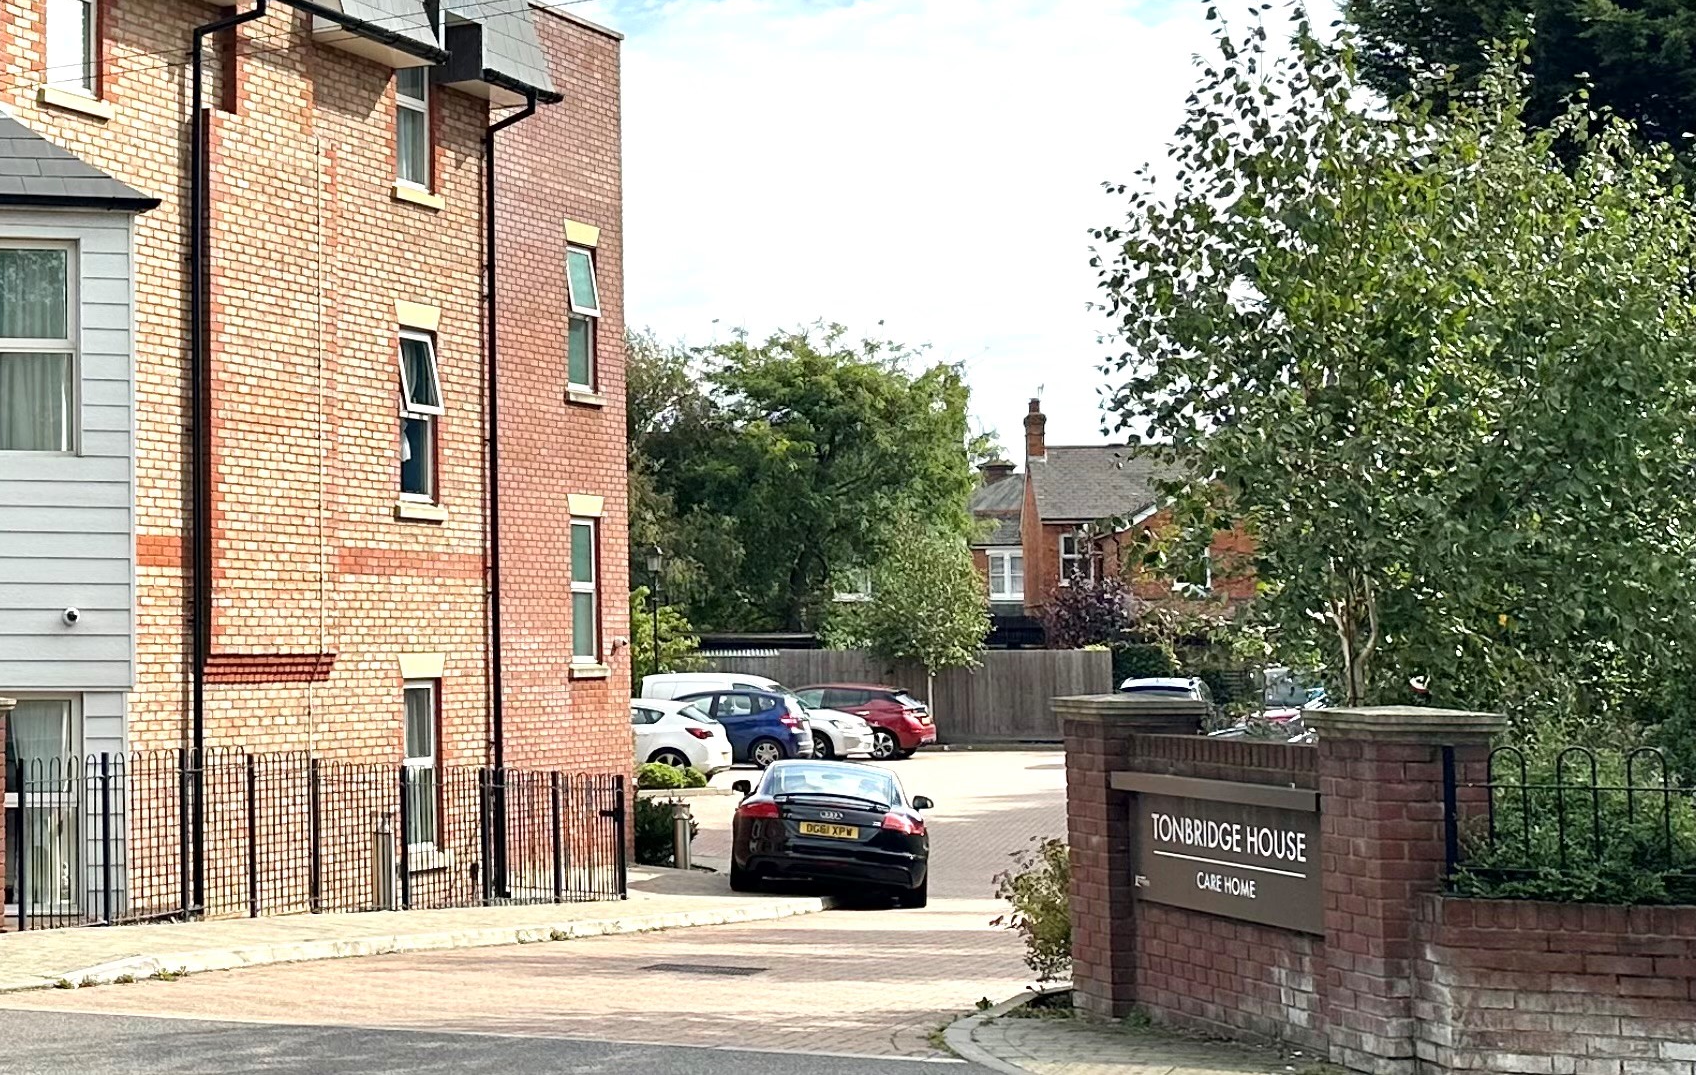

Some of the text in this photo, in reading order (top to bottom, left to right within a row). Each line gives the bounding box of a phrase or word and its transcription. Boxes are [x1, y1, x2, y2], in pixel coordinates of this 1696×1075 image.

[1151, 813, 1307, 863] TONBRIDGE HOUSE
[1196, 871, 1256, 899] CARE HOME
